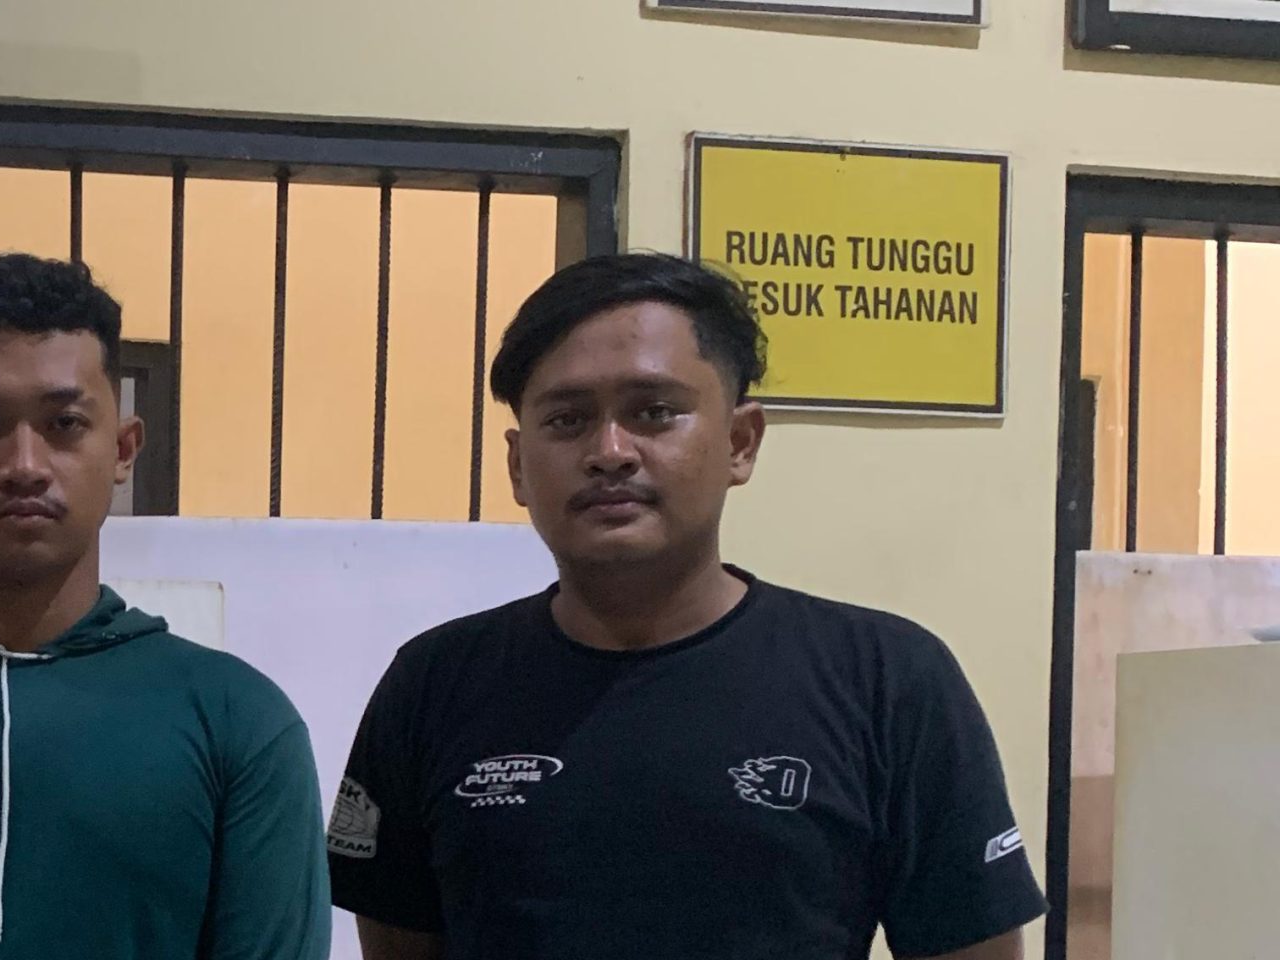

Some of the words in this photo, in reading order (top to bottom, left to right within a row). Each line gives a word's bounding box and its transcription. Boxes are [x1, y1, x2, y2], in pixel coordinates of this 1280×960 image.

[725, 230, 835, 268] RUANG
[846, 236, 974, 276] TUNGGU
[736, 280, 824, 317] ESUK
[834, 285, 978, 324] TAHANAN
[465, 771, 542, 786] FUTURE
[474, 760, 538, 772] YOUTH
